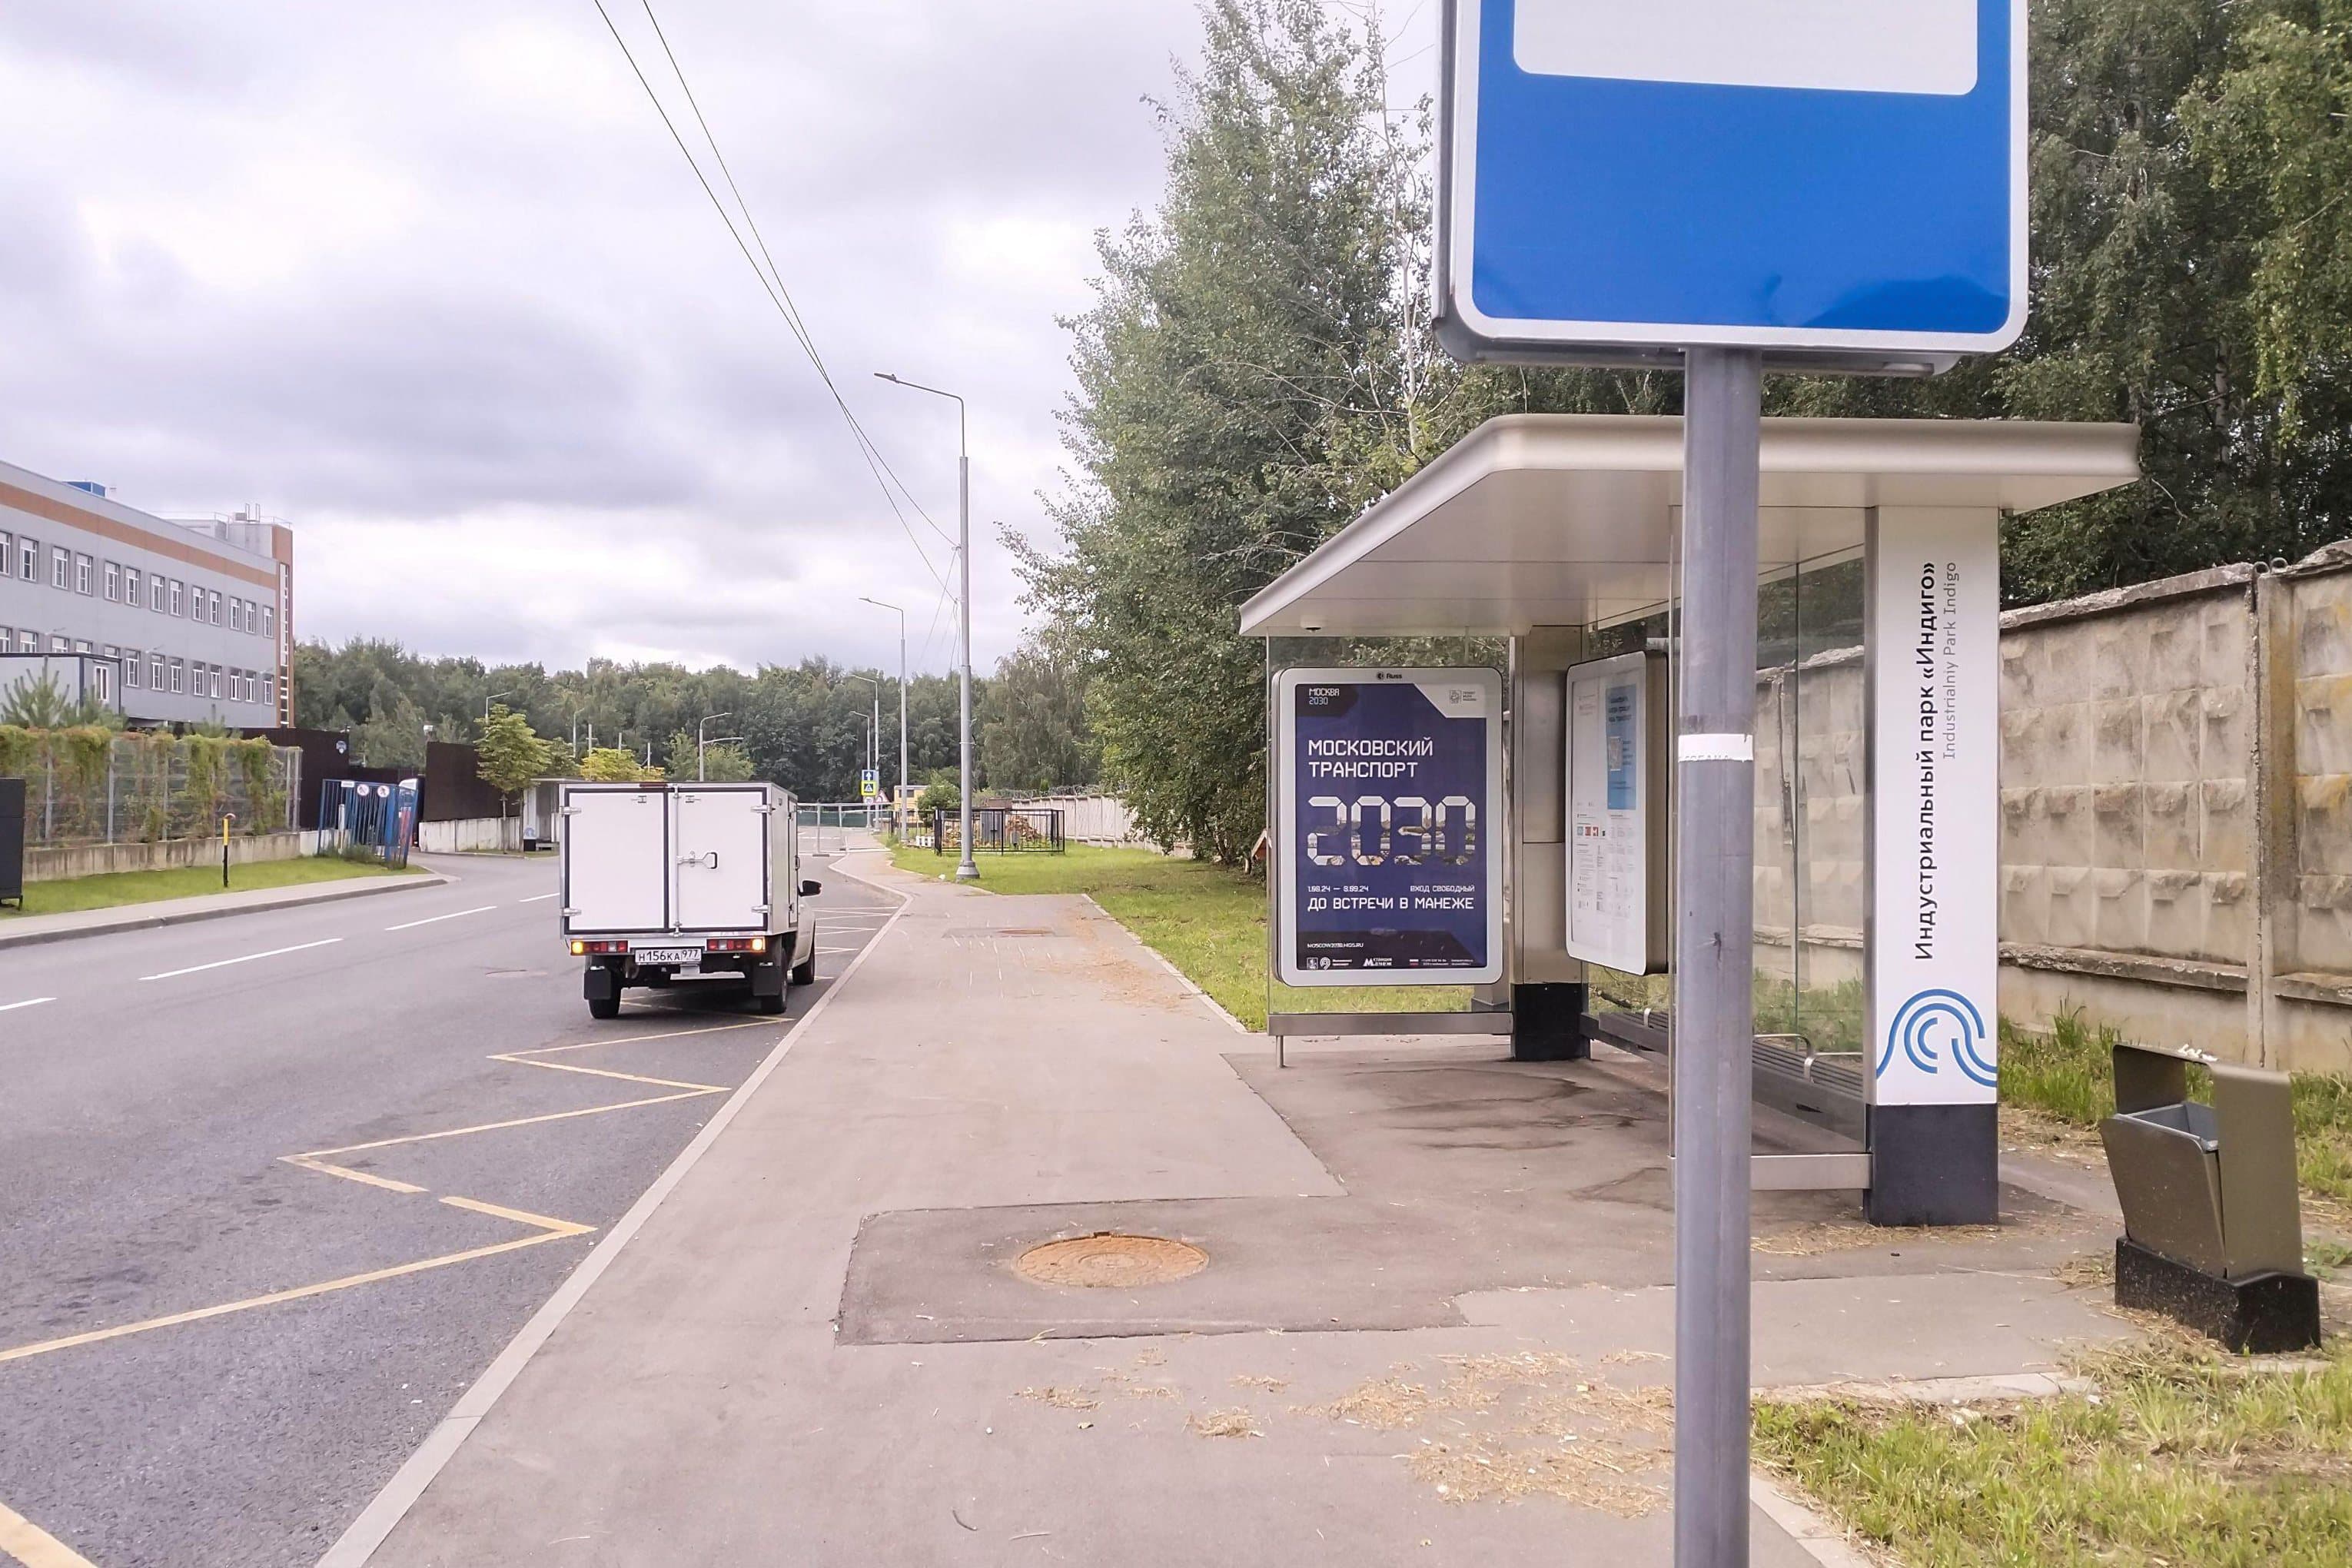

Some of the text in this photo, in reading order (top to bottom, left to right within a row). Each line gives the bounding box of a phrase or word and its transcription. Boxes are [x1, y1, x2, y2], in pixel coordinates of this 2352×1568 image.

[1943, 562, 1959, 759] Industrialniy Park Indigo
[1308, 688, 1340, 696] МОСКВА
[1309, 696, 1329, 706] 2030
[1308, 736, 1433, 756] МОСКОВСКИЙ
[1915, 562, 1938, 960] Индустриальный парк «Индиго»
[1308, 762, 1419, 778] ТРАНСПОРТ
[1307, 796, 1476, 866] 2030
[1410, 884, 1475, 893] ВХОД СВОБОДНЫЙ
[1307, 897, 1474, 912] ДО ВСТРЕЧИ В МАНЕЖЕ
